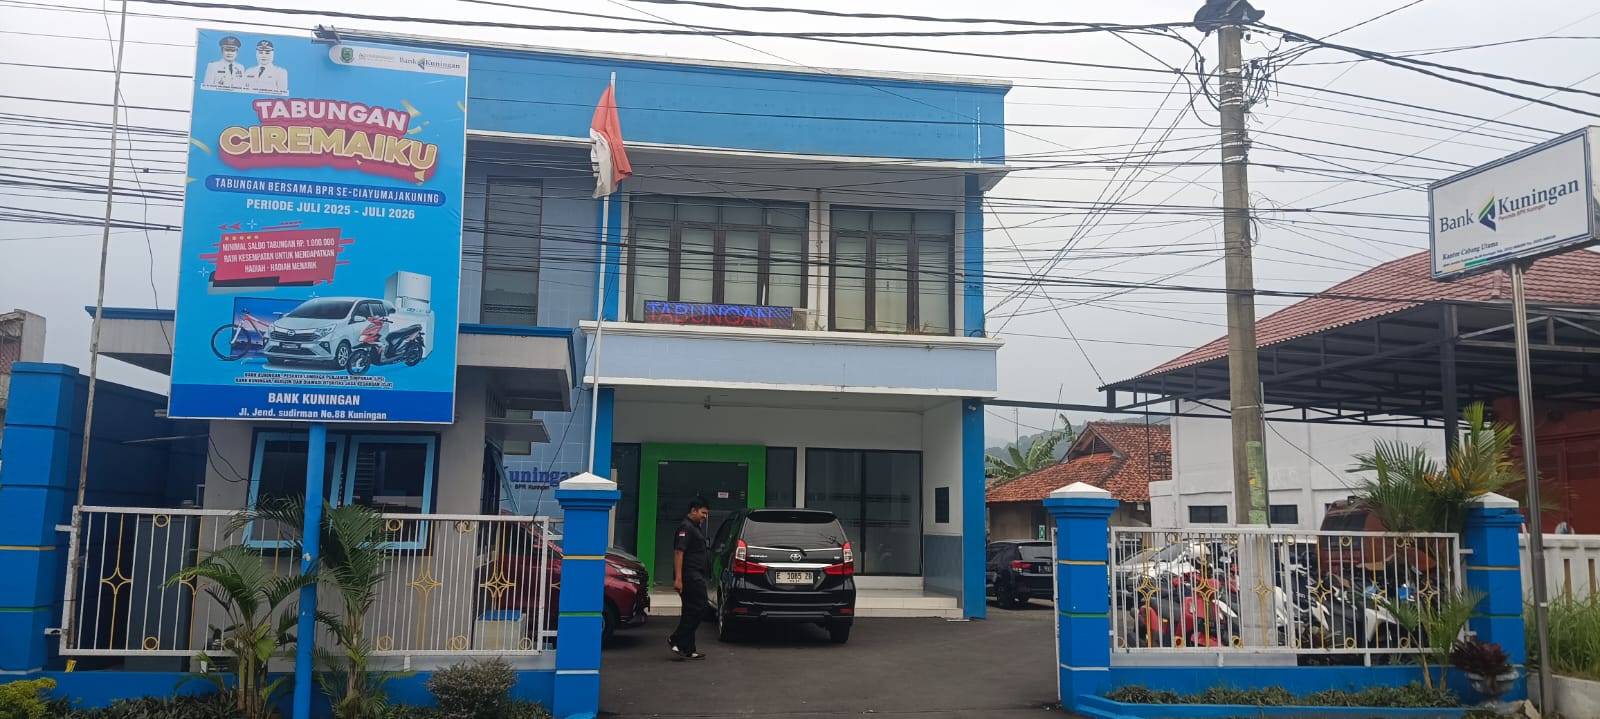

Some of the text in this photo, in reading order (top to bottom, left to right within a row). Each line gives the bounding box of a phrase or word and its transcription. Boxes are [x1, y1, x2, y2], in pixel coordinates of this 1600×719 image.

[400, 57, 416, 65] Bank
[425, 59, 460, 70] Kuningan
[256, 100, 407, 130] TABUNGAN
[219, 126, 438, 170] CIREMAIKU
[216, 178, 440, 204] TABUNGAN BERSAMA BPR SE-CIAYUMAJAKUNING
[246, 198, 293, 212] PERIODE
[296, 200, 320, 213] JULI
[324, 203, 350, 215] 2025
[362, 206, 386, 218] JULI
[388, 208, 415, 220] 2026
[1440, 180, 1579, 232] Bank Kuningan
[222, 242, 248, 252] MINIMAL
[248, 241, 266, 250] SALDO
[266, 240, 296, 249] TABUNGAN
[306, 238, 334, 247] 1.000.000
[1461, 246, 1480, 256] Cabang
[1481, 242, 1499, 250] Utama
[238, 252, 274, 262] KESEMPATAN
[275, 251, 294, 260] UNTUK
[295, 249, 335, 259] MENDAPATKAN
[245, 264, 266, 273] HADIAH
[270, 262, 292, 272] HADIAH
[292, 261, 317, 270] MENARIK
[646, 302, 774, 328] TABUNGAN
[268, 392, 360, 406] BANK KUNINGAN
[238, 408, 387, 421] Jl. Jend. sudirman No.88 Kuningan
[504, 466, 579, 487] uninga
